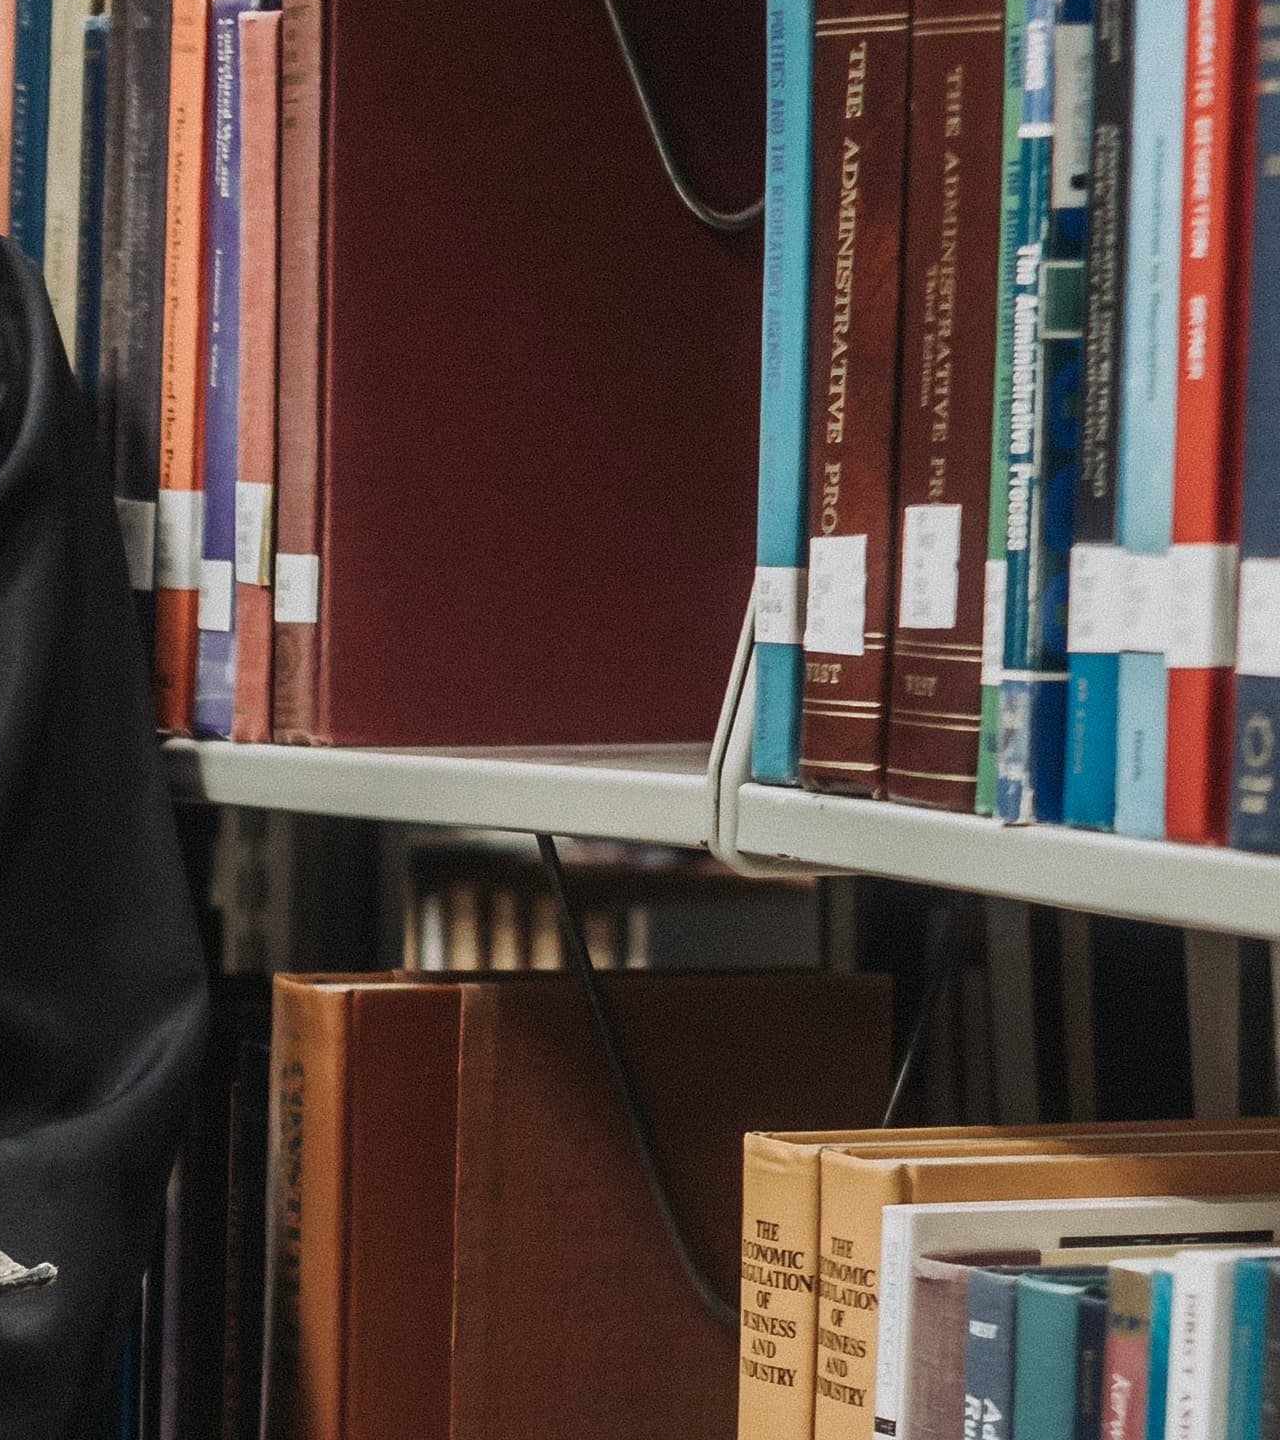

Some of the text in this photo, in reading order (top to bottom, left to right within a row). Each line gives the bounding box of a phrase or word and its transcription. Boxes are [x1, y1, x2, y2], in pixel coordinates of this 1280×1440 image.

[845, 40, 867, 118] THE
[943, 65, 964, 137] THE
[765, 9, 785, 393] POLITICS AND THE REGULATORY AGENCIES
[1015, 242, 1041, 286] The
[825, 136, 861, 444] ADMINISTRATIVE
[930, 150, 961, 442] ADMINISTRATIVE
[1009, 292, 1039, 456] Administrative
[1006, 462, 1034, 552] Process
[755, 1219, 780, 1242] THE
[830, 1236, 854, 1260] THE
[741, 1261, 815, 1293] EGULATION
[756, 1289, 772, 1310] OF
[819, 1278, 880, 1311] EGULATION
[743, 1309, 798, 1340] USINESS
[830, 1309, 845, 1328] OF
[751, 1336, 777, 1360] AND
[819, 1327, 868, 1359] USINESS
[742, 1356, 798, 1388] NDUSTRY
[824, 1356, 849, 1378] AND
[816, 1374, 868, 1408] NDUSTRY
[1176, 1391, 1192, 1440] AND
